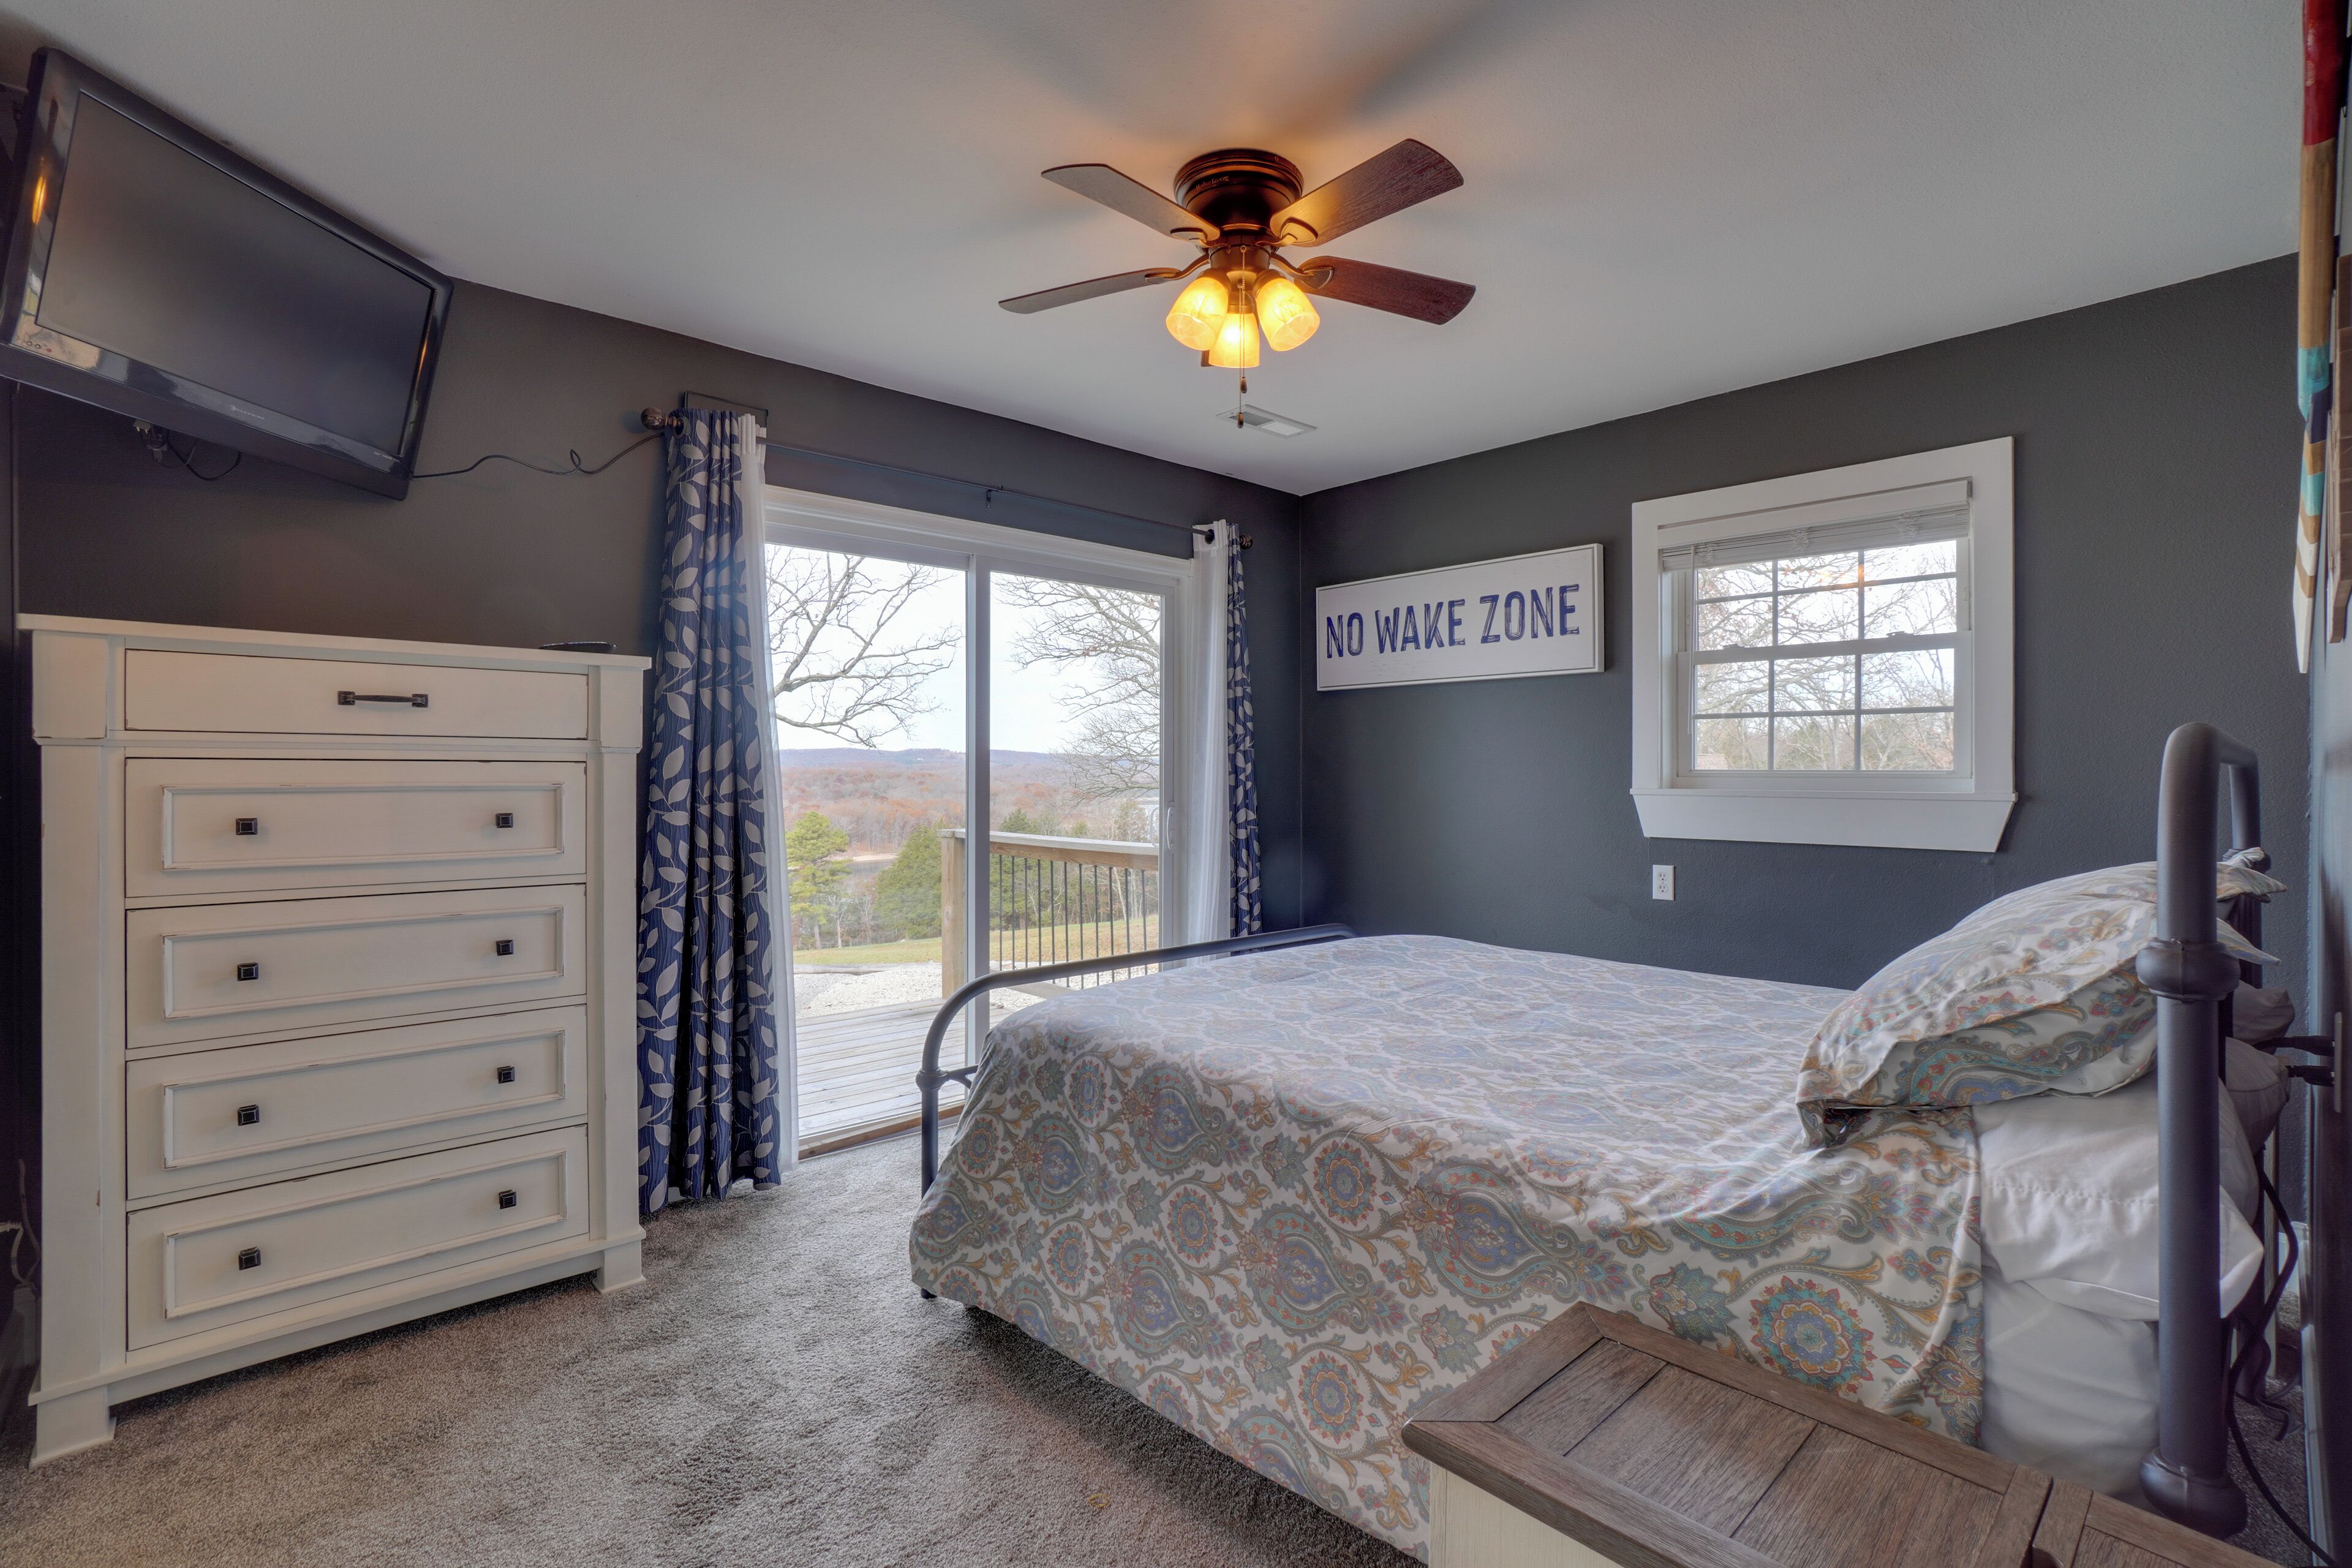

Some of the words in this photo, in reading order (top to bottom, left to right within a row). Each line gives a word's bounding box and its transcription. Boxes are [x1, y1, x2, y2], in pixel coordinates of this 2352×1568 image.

[1327, 612, 1363, 658] NO
[1374, 598, 1466, 654] WAKE
[1480, 584, 1580, 644] ZONE
